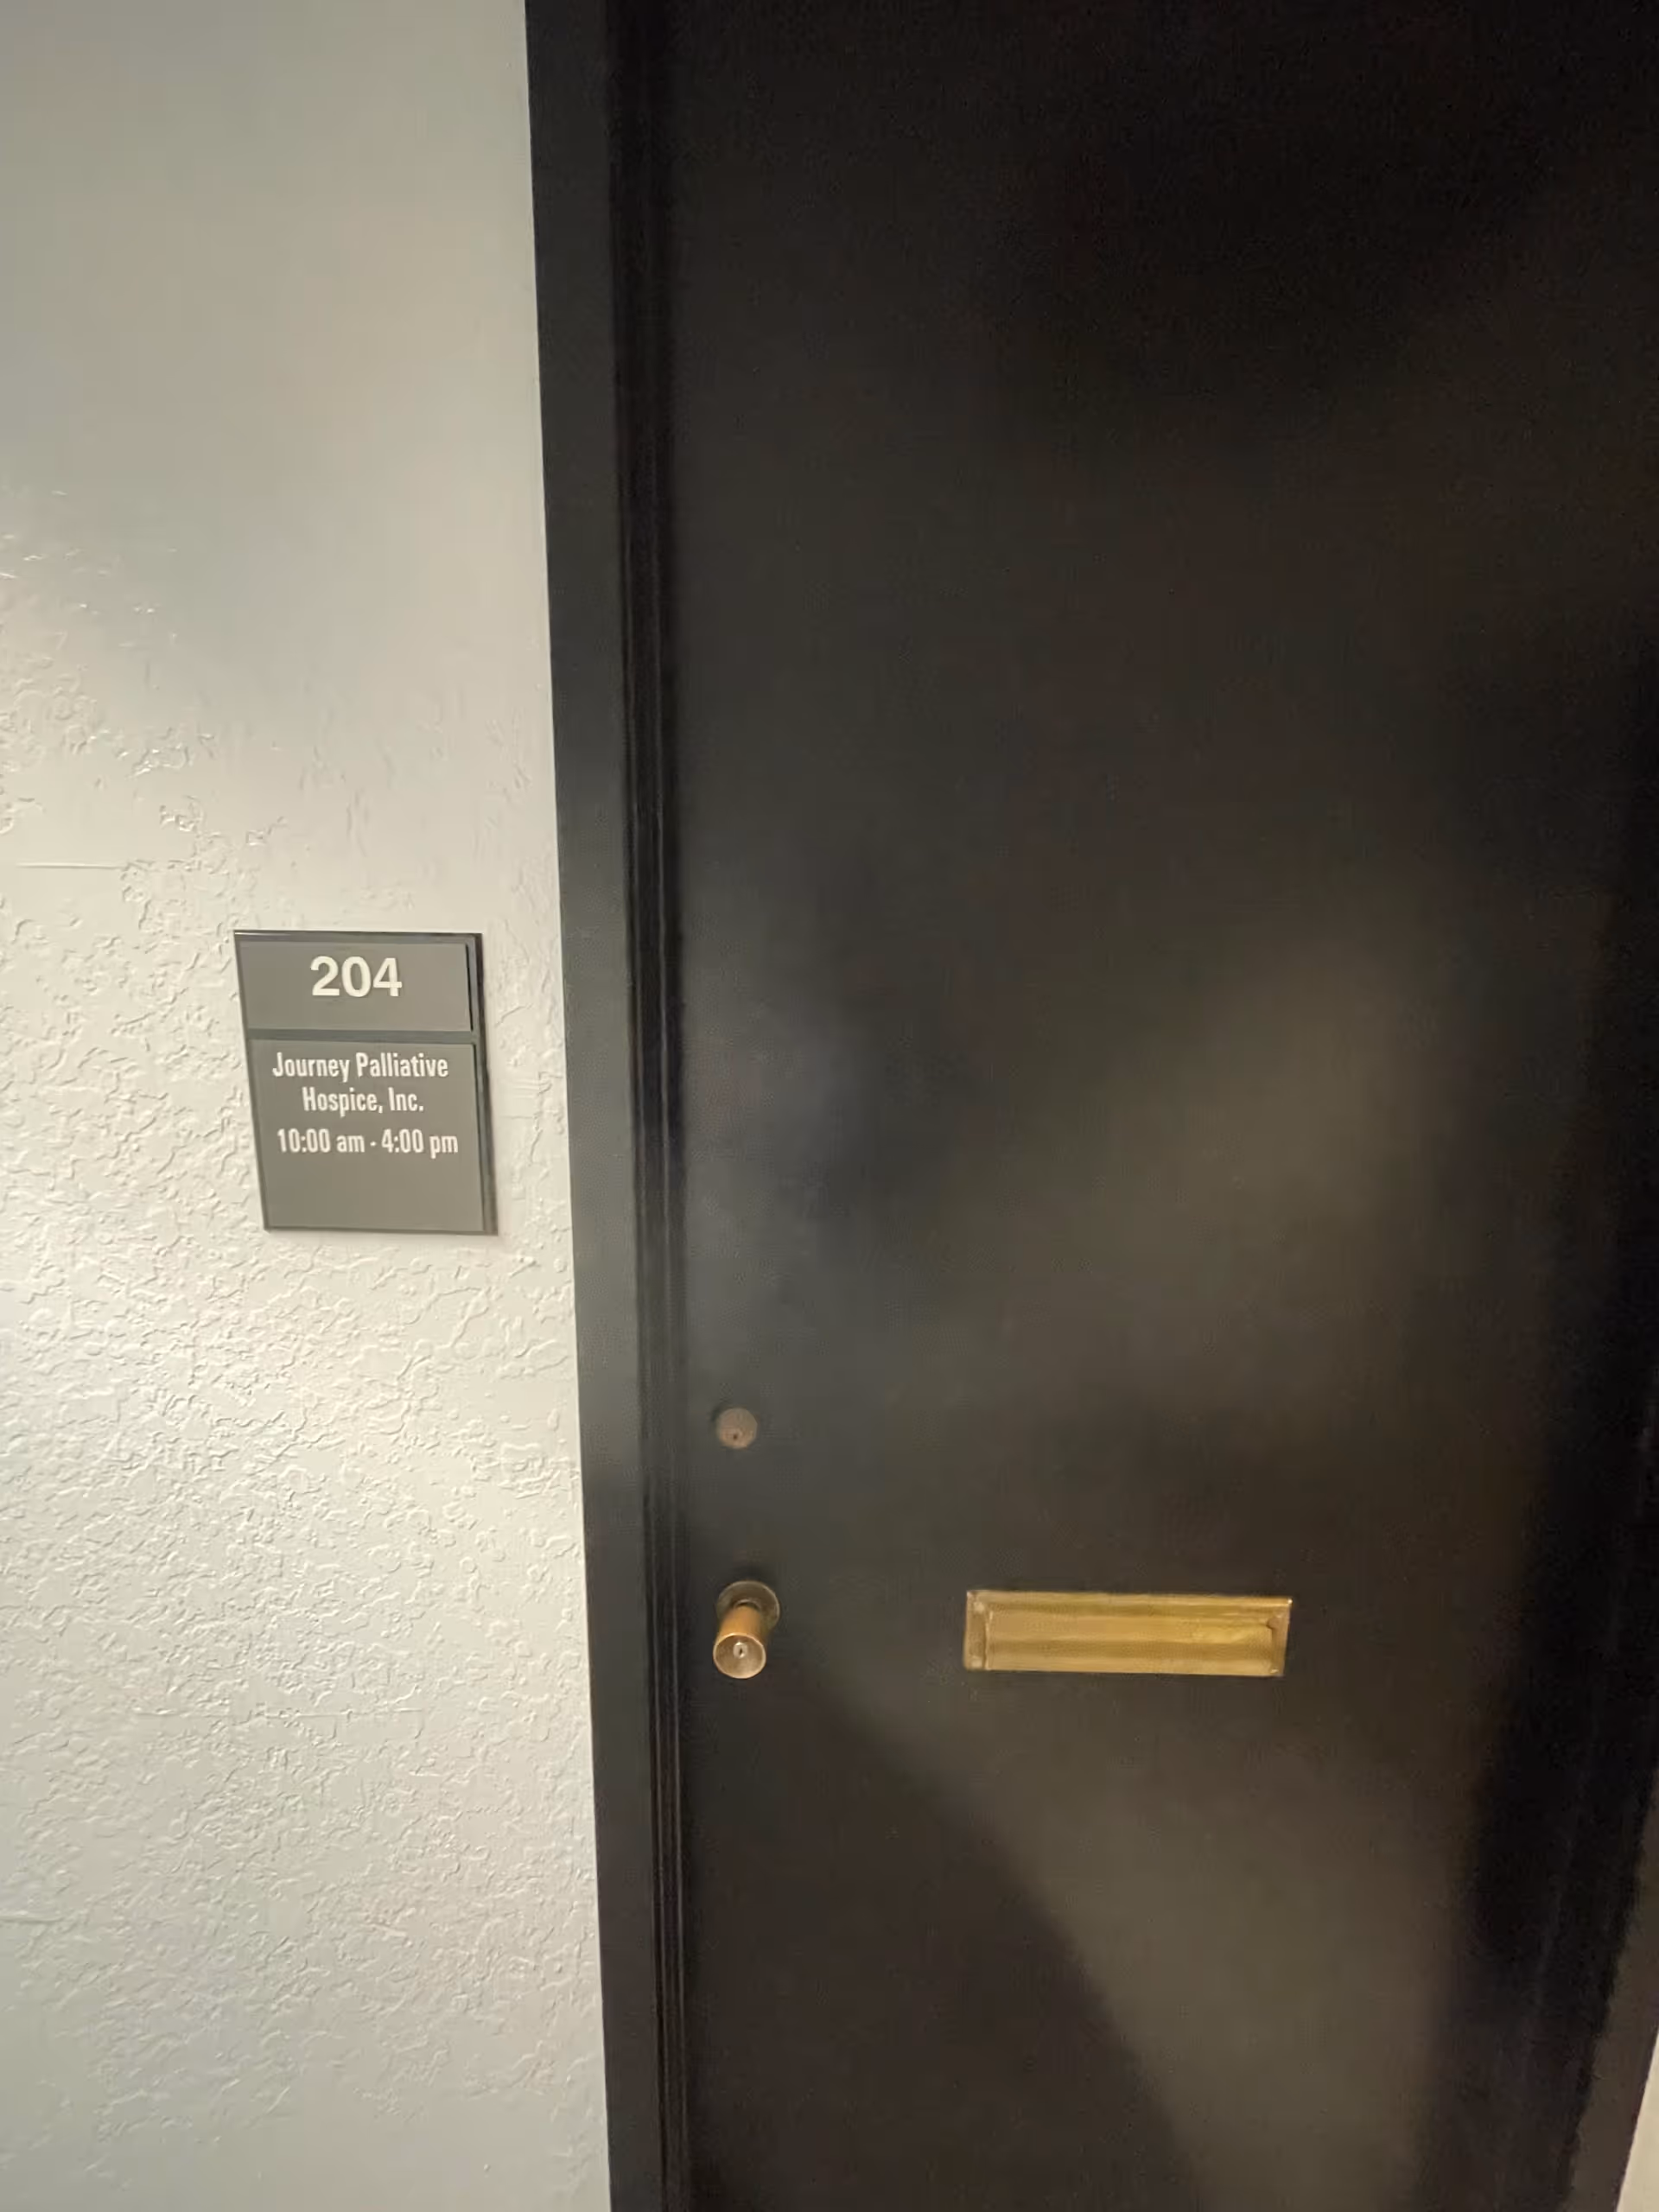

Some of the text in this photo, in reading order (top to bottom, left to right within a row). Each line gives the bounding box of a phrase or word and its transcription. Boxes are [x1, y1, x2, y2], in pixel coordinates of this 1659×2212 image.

[309, 955, 404, 998] 204
[271, 1051, 449, 1084] Journey Palliative
[301, 1085, 425, 1118] Hospice, Inc.
[276, 1127, 332, 1154] 10:00
[335, 1134, 365, 1154] am
[380, 1128, 425, 1154] 4:00
[429, 1134, 460, 1160] pm
